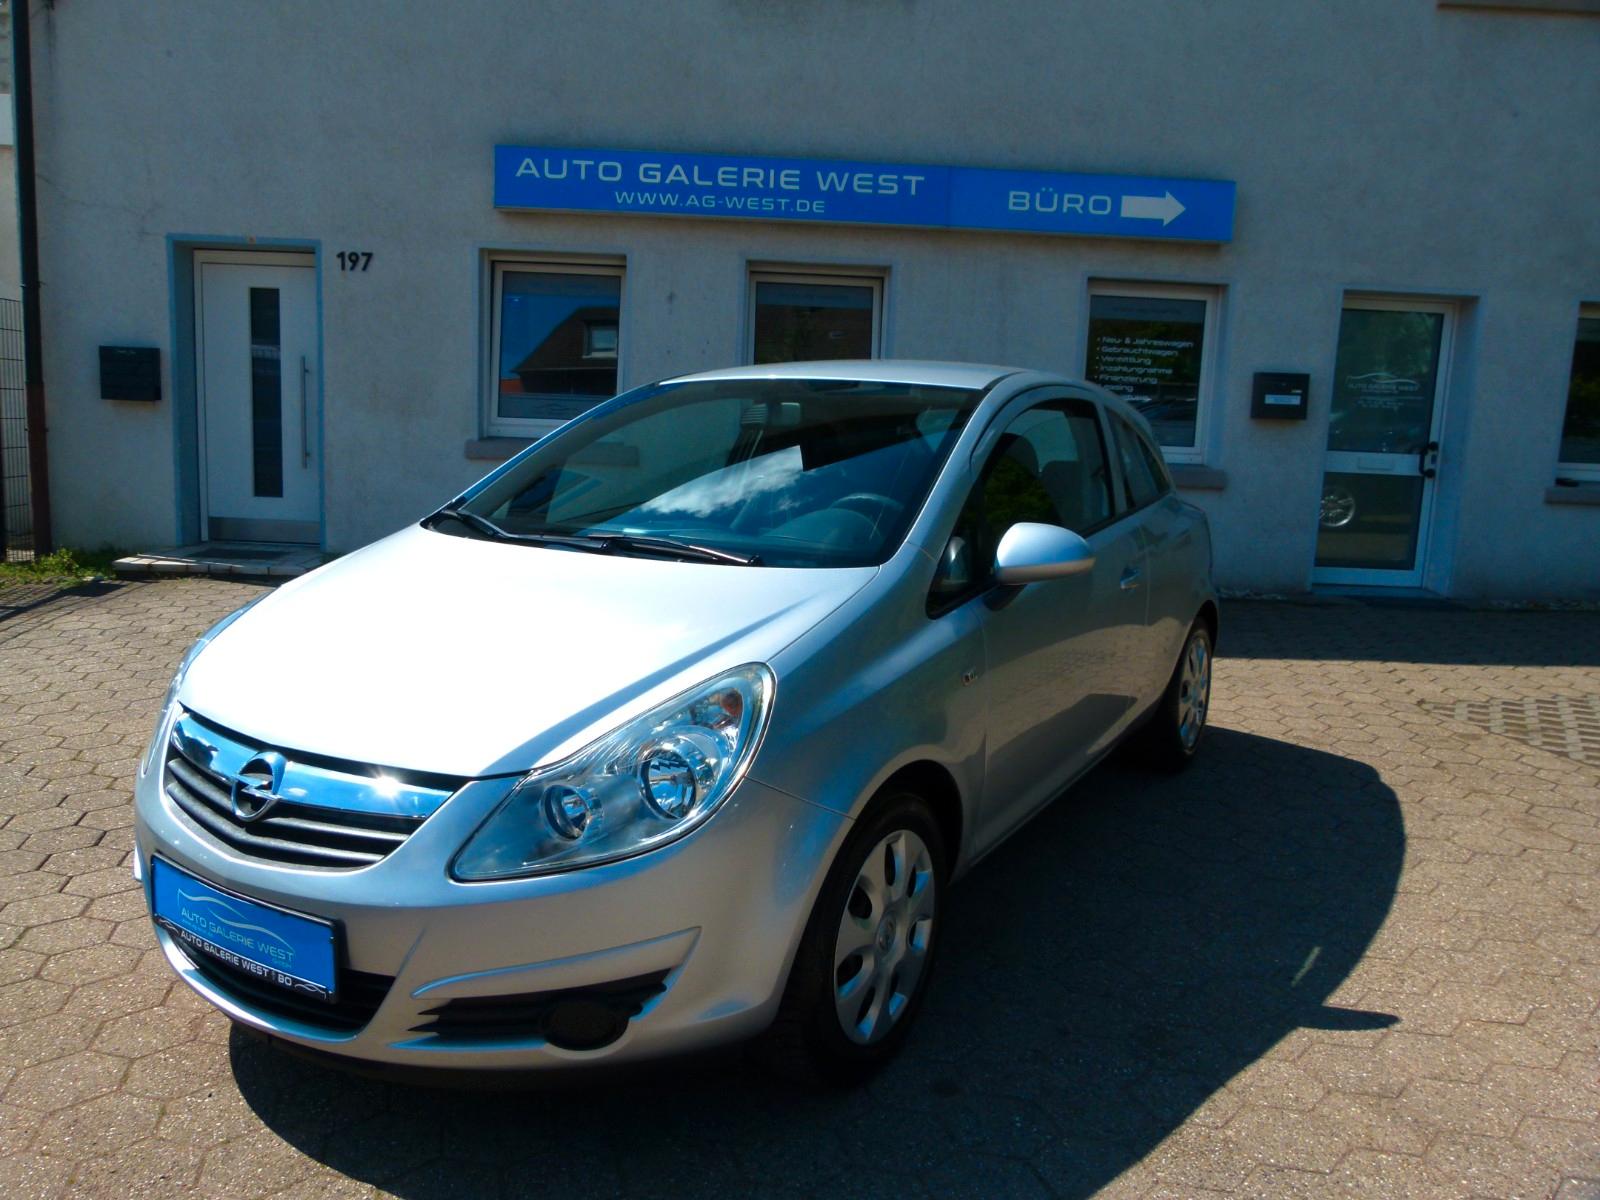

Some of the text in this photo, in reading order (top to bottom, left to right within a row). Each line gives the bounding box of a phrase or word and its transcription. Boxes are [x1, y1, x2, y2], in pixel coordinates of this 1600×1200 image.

[515, 157, 925, 196] AUTO GALERIE WEST
[614, 190, 825, 213] WWW.AG-WEST.DE
[1007, 186, 1112, 215] BÜRO
[336, 250, 374, 272] 197
[180, 906, 207, 928] AUTO
[208, 921, 255, 949] GALERIE
[257, 941, 294, 962] WEST
[180, 930, 293, 986] AUTO GALERIE WEST BO
